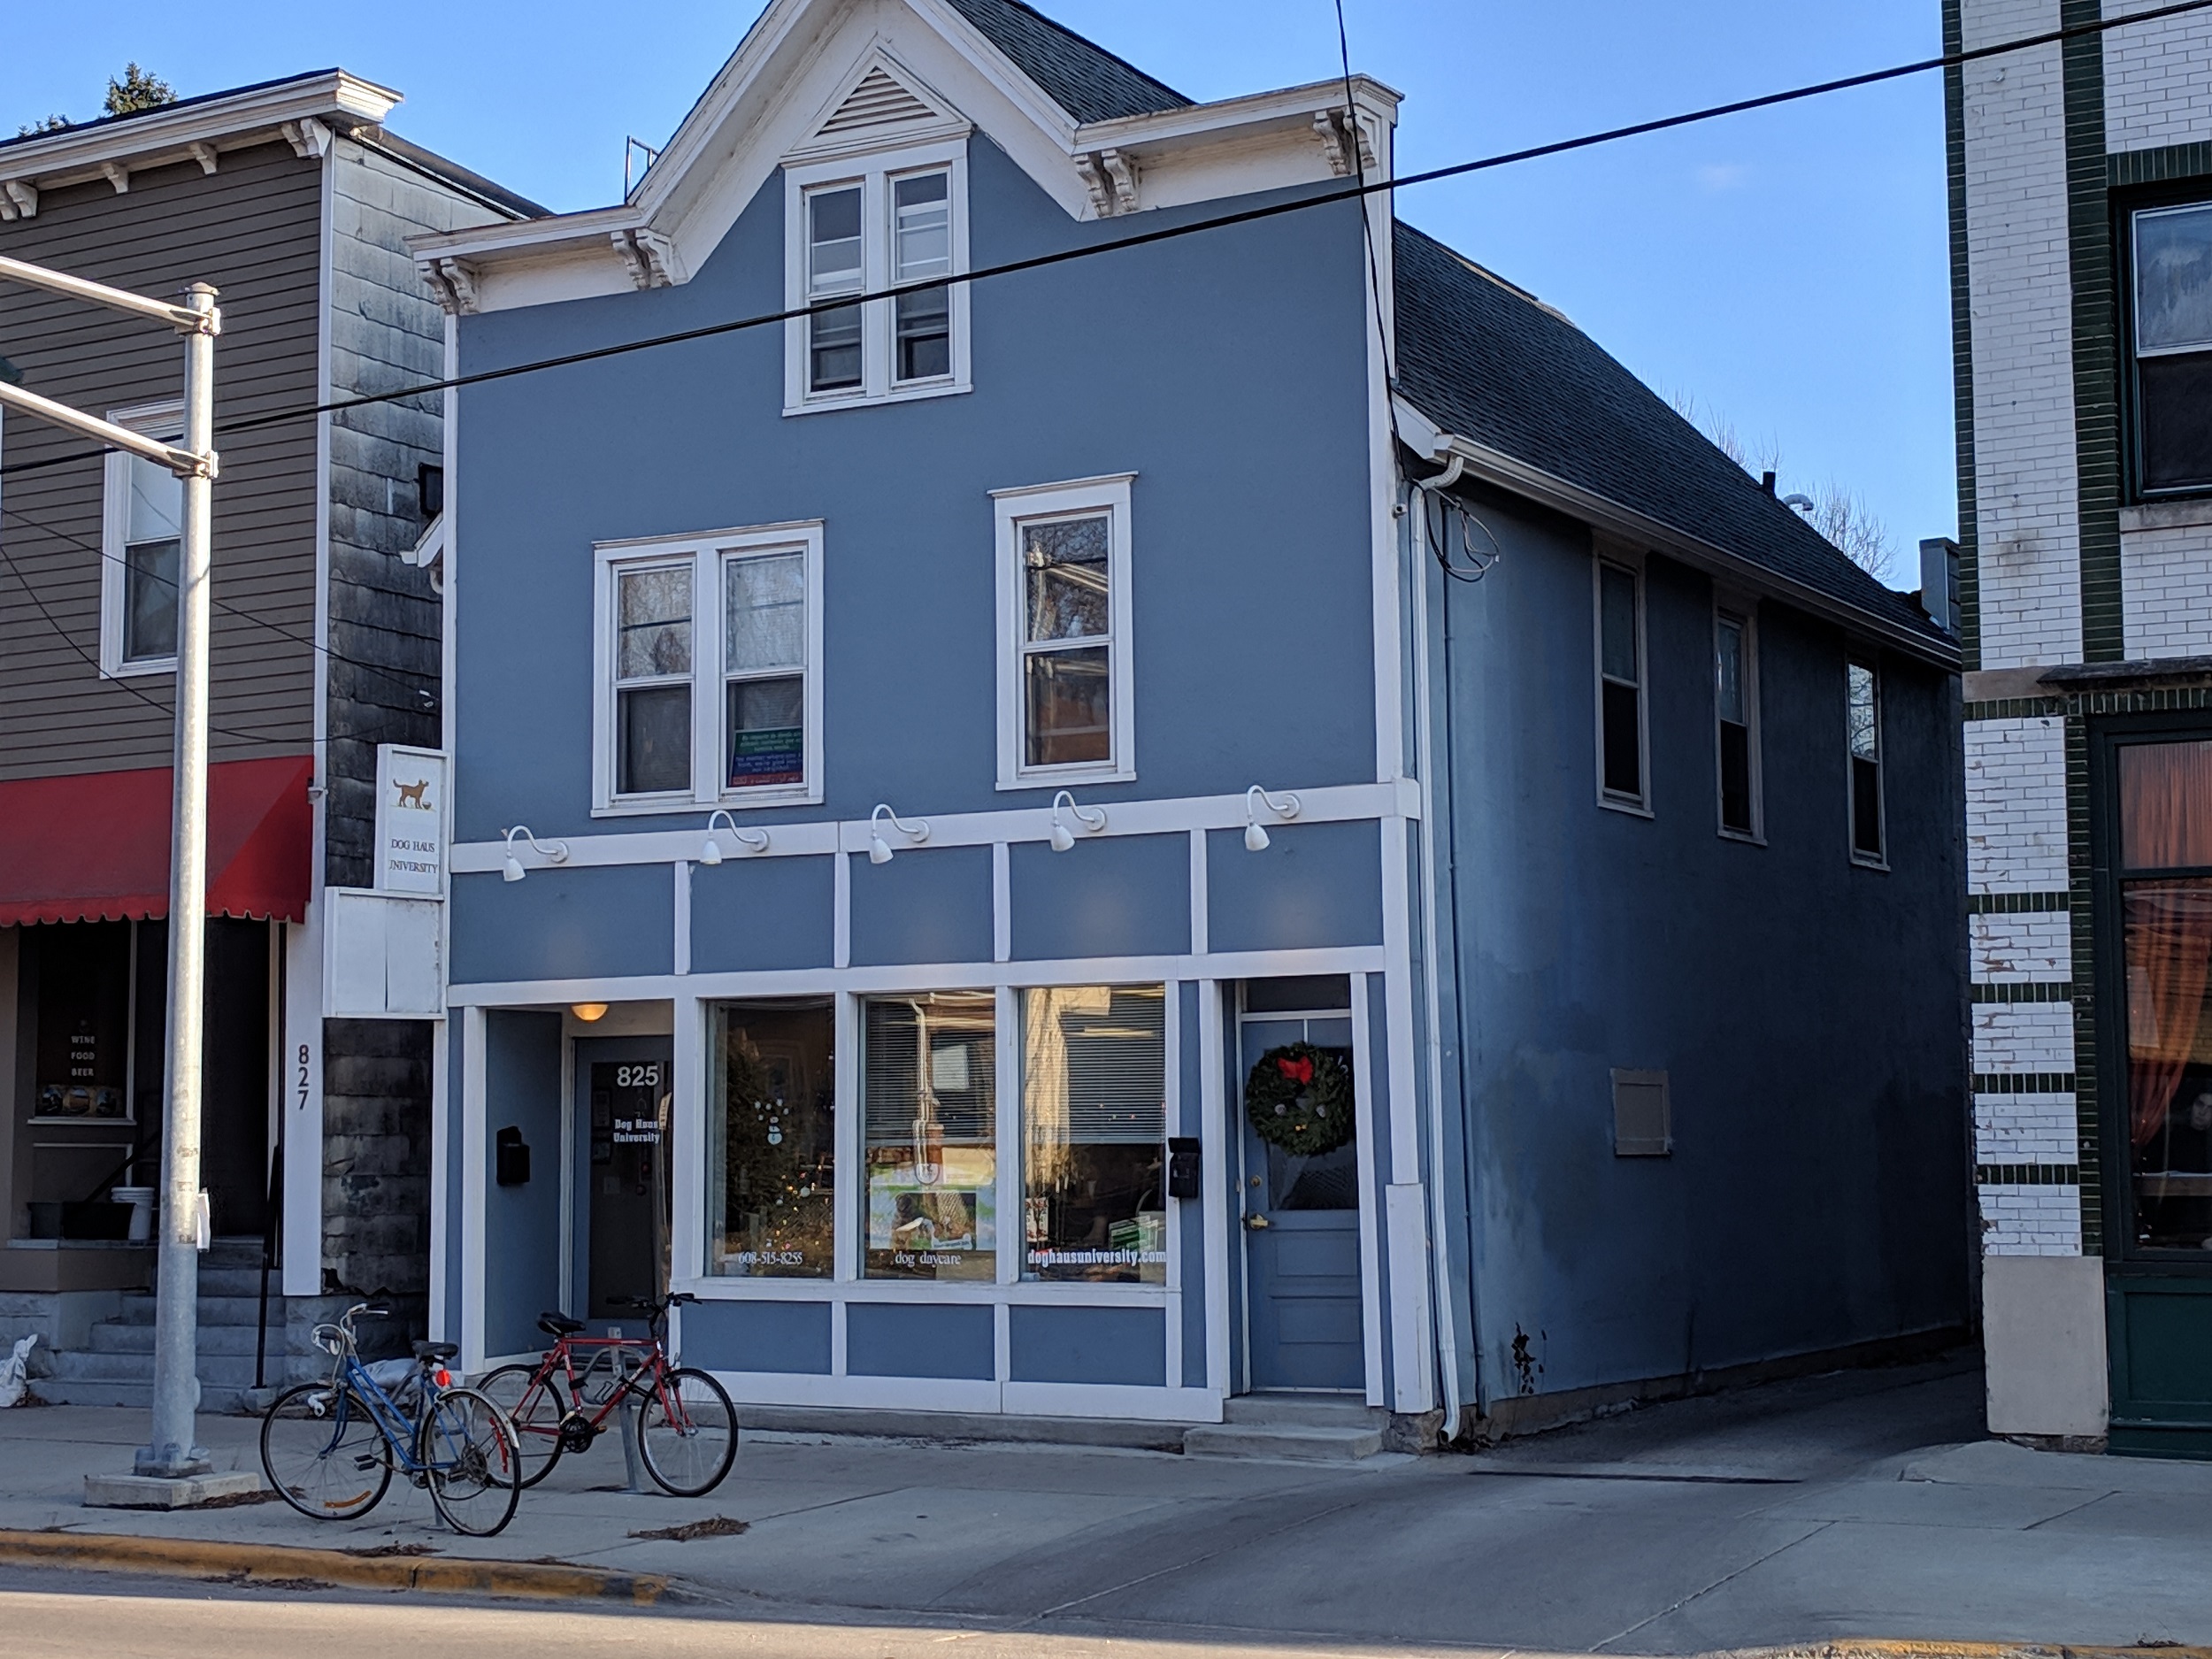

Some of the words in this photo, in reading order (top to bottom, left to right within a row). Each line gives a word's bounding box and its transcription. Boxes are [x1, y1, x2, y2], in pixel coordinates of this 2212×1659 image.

[391, 839, 410, 850] DOG
[412, 841, 435, 853] HAUS
[71, 1035, 95, 1044] WINE
[71, 1051, 95, 1060] FOOD
[71, 1067, 94, 1077] BEER
[297, 1044, 309, 1110] 827
[617, 1065, 659, 1087] 825
[614, 1118, 632, 1131] Dog
[613, 1132, 661, 1144] University
[738, 1251, 803, 1265] 608-515-8255
[895, 1250, 916, 1267] dog
[919, 1250, 962, 1267] daycare
[1027, 1248, 1167, 1268] doghausuniversity.com
